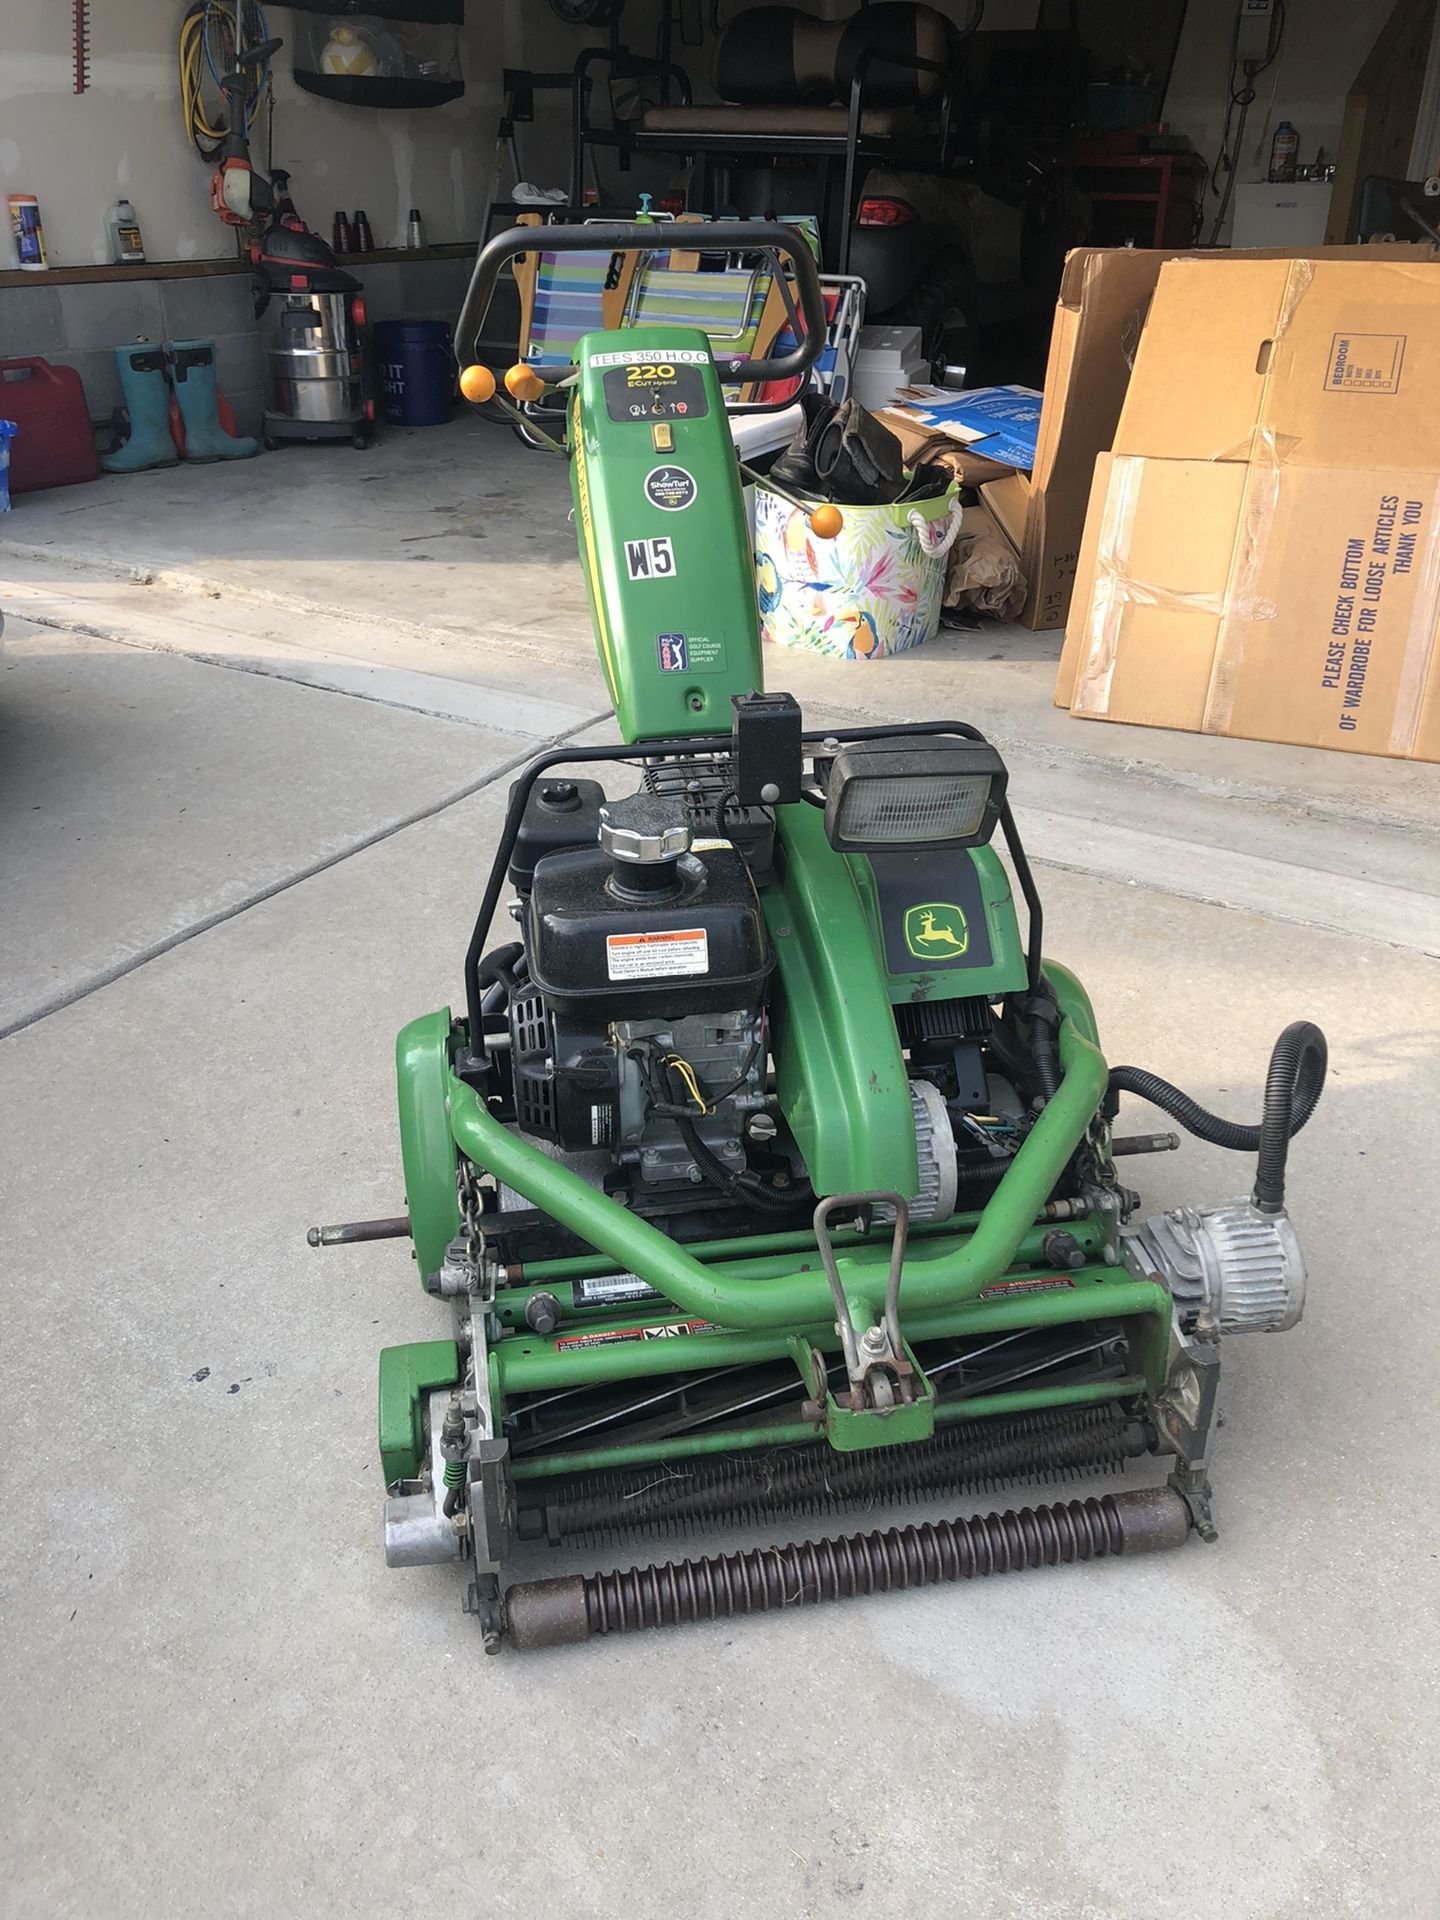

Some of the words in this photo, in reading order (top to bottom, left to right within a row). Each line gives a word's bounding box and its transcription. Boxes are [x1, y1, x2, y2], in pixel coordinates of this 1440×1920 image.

[592, 353, 632, 365] TEES
[636, 352, 662, 362] 350
[626, 365, 676, 380] 220
[1332, 340, 1350, 384] BEDROOM
[650, 480, 690, 490] ShowTurf
[1372, 496, 1400, 555] ARTICLES
[1402, 500, 1424, 526] YOU
[628, 538, 672, 577] W5
[1340, 538, 1366, 590] BOTTOM
[1392, 533, 1417, 574] THANK
[1363, 562, 1386, 602] LOOSE
[1332, 595, 1355, 636] CHECK
[1358, 608, 1378, 632] FOR
[1322, 641, 1346, 688] PLEASE
[1343, 638, 1372, 708] WARDROBE
[1339, 714, 1357, 730] OF
[588, 1331, 616, 1340] DANGER
